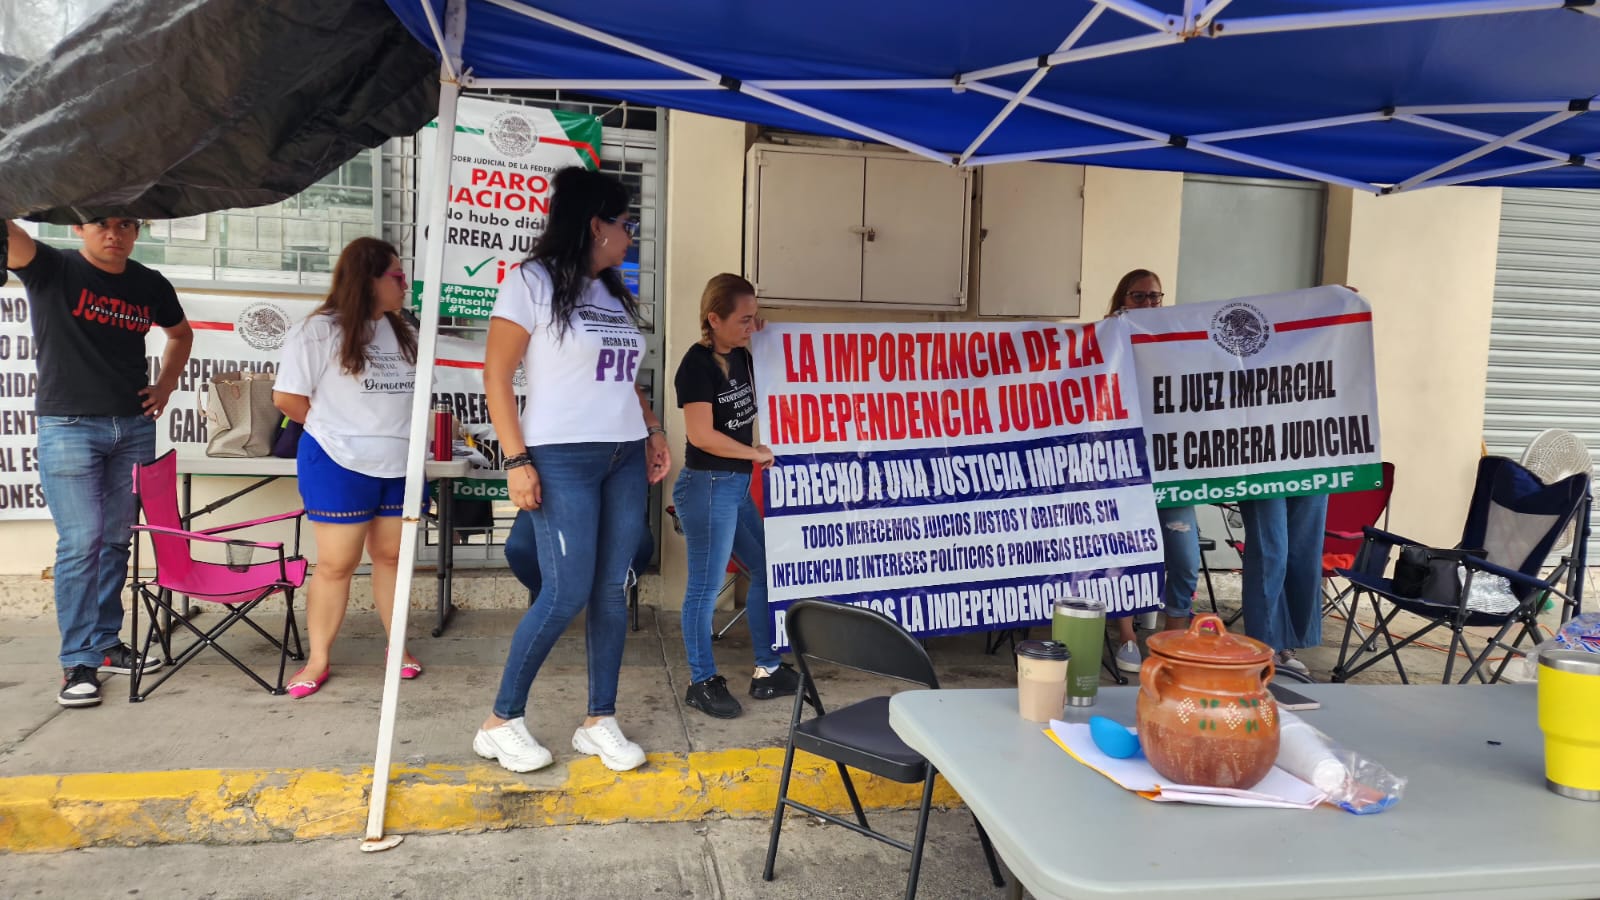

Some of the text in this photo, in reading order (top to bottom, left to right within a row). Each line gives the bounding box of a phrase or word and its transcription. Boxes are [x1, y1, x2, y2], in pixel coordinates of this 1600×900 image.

[451, 154, 472, 164] ODER
[474, 157, 506, 168] JUDICIAL
[508, 161, 519, 169] DE
[471, 168, 549, 194] PARO
[469, 209, 510, 227] hubo
[424, 224, 503, 250] RRERA
[444, 284, 499, 298] #ParoN
[447, 304, 491, 317] #Todo
[595, 349, 640, 382] PJF
[782, 323, 1104, 383] LA IMPORTANCIA DE LA
[1152, 360, 1336, 414] EL JUEZ IMPARCIAL
[0, 410, 37, 435] ENT
[768, 373, 1129, 445] INDEPENDENCIA JUDICIAL
[1152, 414, 1375, 472] DE CARRERA JUDICIAL
[434, 481, 508, 497] Todos
[769, 438, 1143, 508] DERECHO A UNA JUSTICIA IMPARCIAL
[1153, 471, 1354, 504] #TodosSomosPJF
[801, 498, 1120, 549] TODOS MERECEMOS JUICIOS JUSTOS Y OBJETIVOS, SIN
[772, 527, 1159, 588] INFLUENCIA DE INTERESES POLÍTICOS O PROMESAS ELECTORALES
[900, 596, 924, 632] LA
